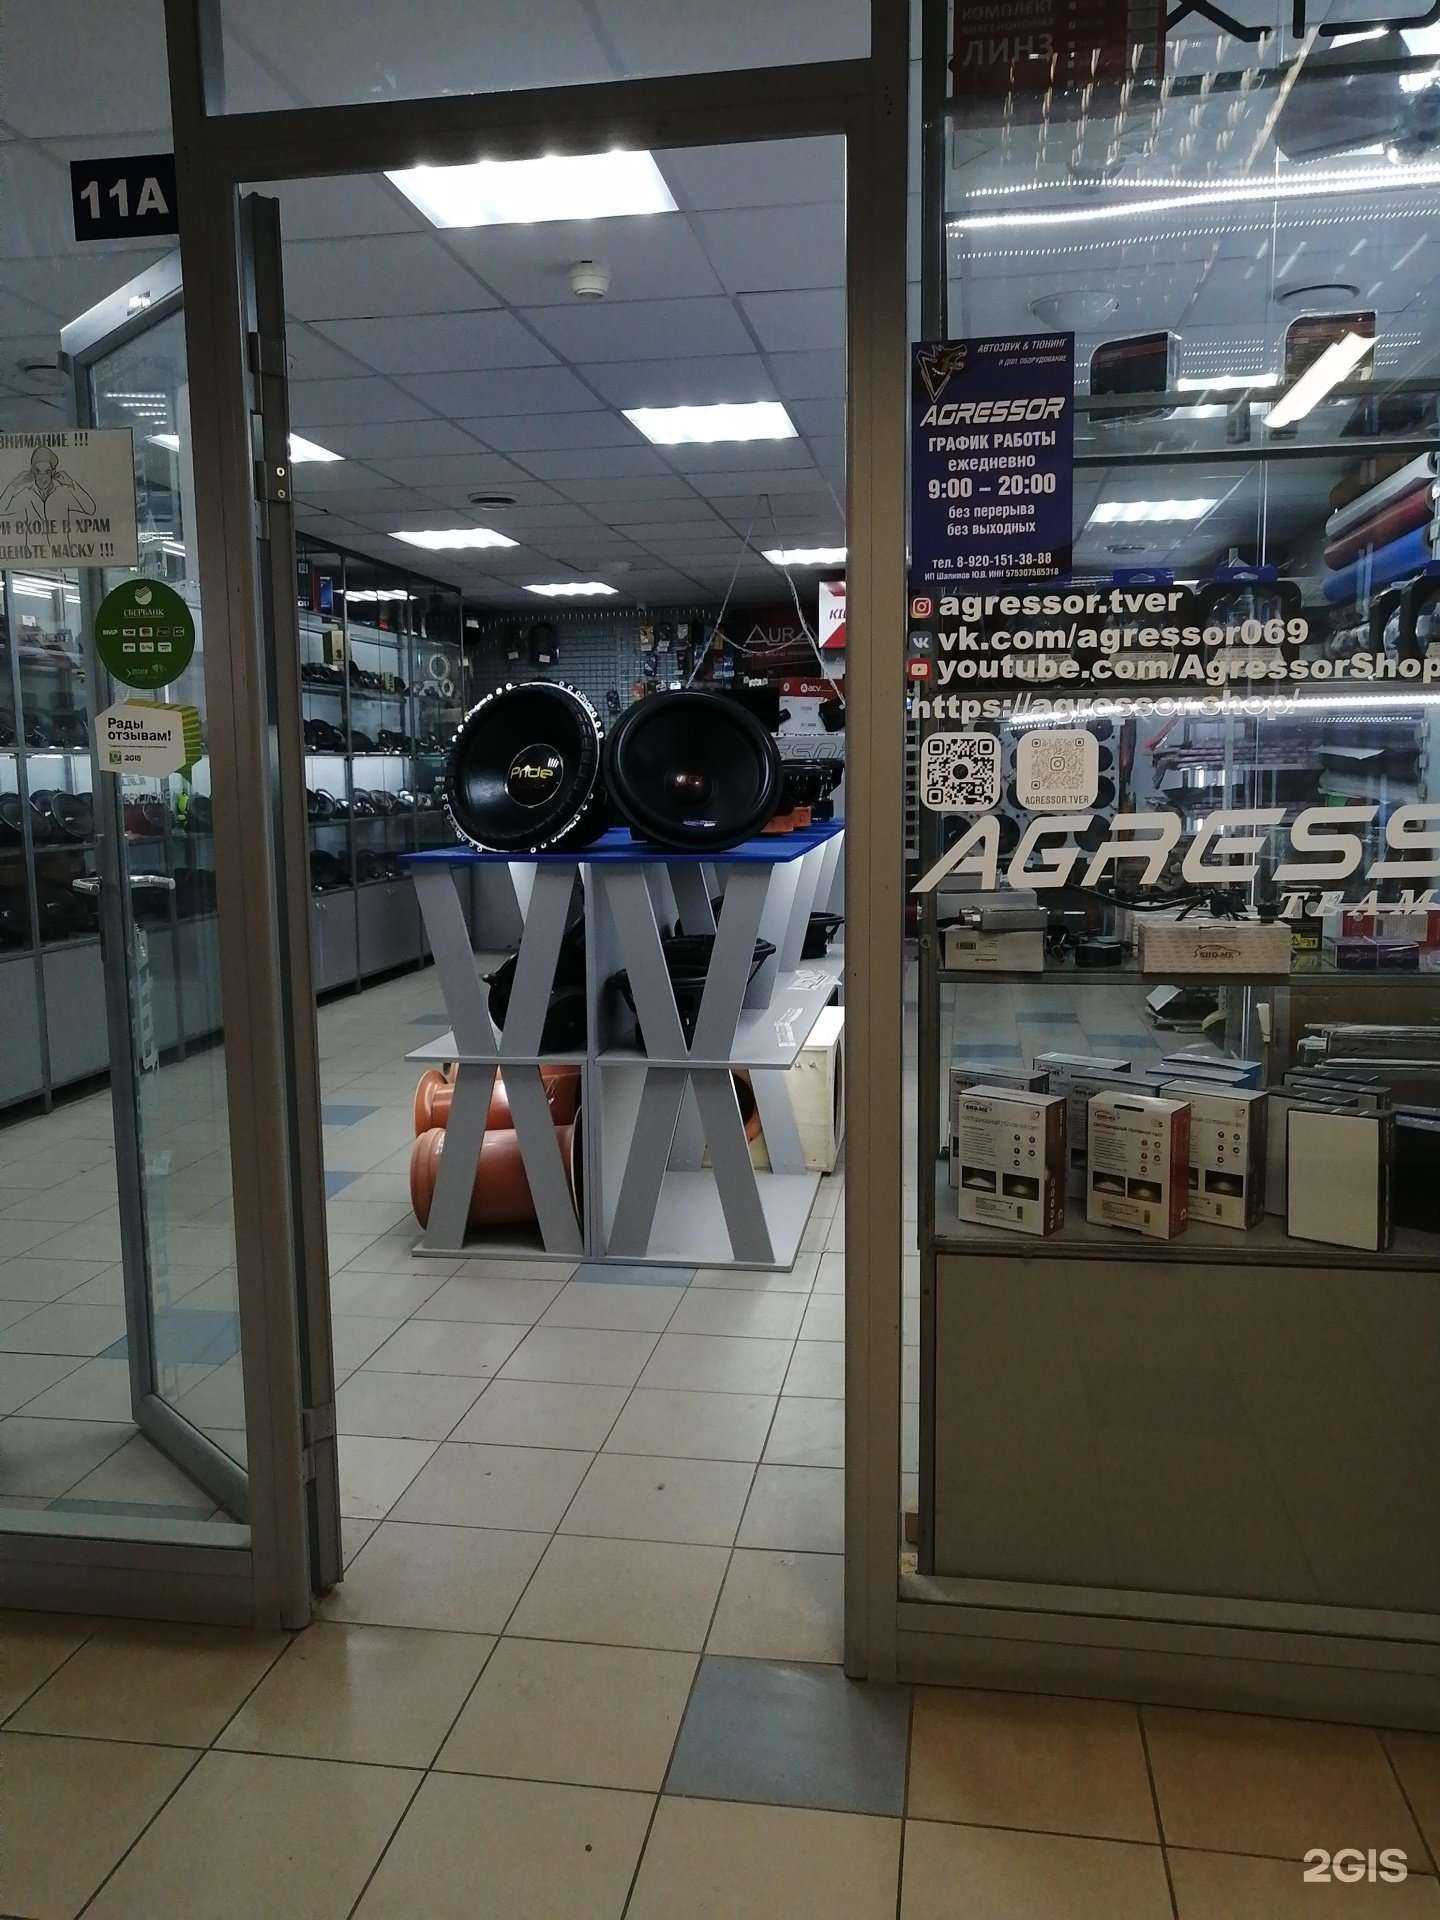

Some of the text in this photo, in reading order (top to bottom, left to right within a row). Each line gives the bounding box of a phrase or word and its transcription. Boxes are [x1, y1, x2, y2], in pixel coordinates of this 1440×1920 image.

[962, 33, 1054, 66] ЛИНЗ
[977, 342, 1021, 353] АВТОЗВУК
[1032, 338, 1067, 349] ТЮНИНГ
[919, 396, 1065, 427] AGRESSOR
[928, 431, 1056, 452] ГРАФИК РАБОТЫ
[948, 454, 1036, 472] ежедневно
[928, 478, 973, 499] 9:00
[998, 473, 1056, 495] 20:00
[948, 504, 1035, 520] без перерыва
[16, 519, 59, 536] ВХОДЕ
[76, 518, 111, 534] ХРАМ
[947, 521, 1036, 537] без выходных
[51, 543, 95, 559] МАСКУ
[932, 552, 1053, 569] тел. 8-920-151-38-88
[924, 572, 935, 581] ИП
[123, 608, 165, 617] СБЕРБАНК
[939, 588, 1183, 622] agressor.tver
[938, 617, 1309, 655] vk.com/agressor069
[937, 652, 1440, 686] youtube.com/AgressorShop
[107, 717, 144, 731] Рады
[107, 730, 172, 742] отзывам!
[511, 765, 554, 779] Pride
[910, 803, 1440, 893] AGRESS
[1278, 889, 1438, 918] TEAM
